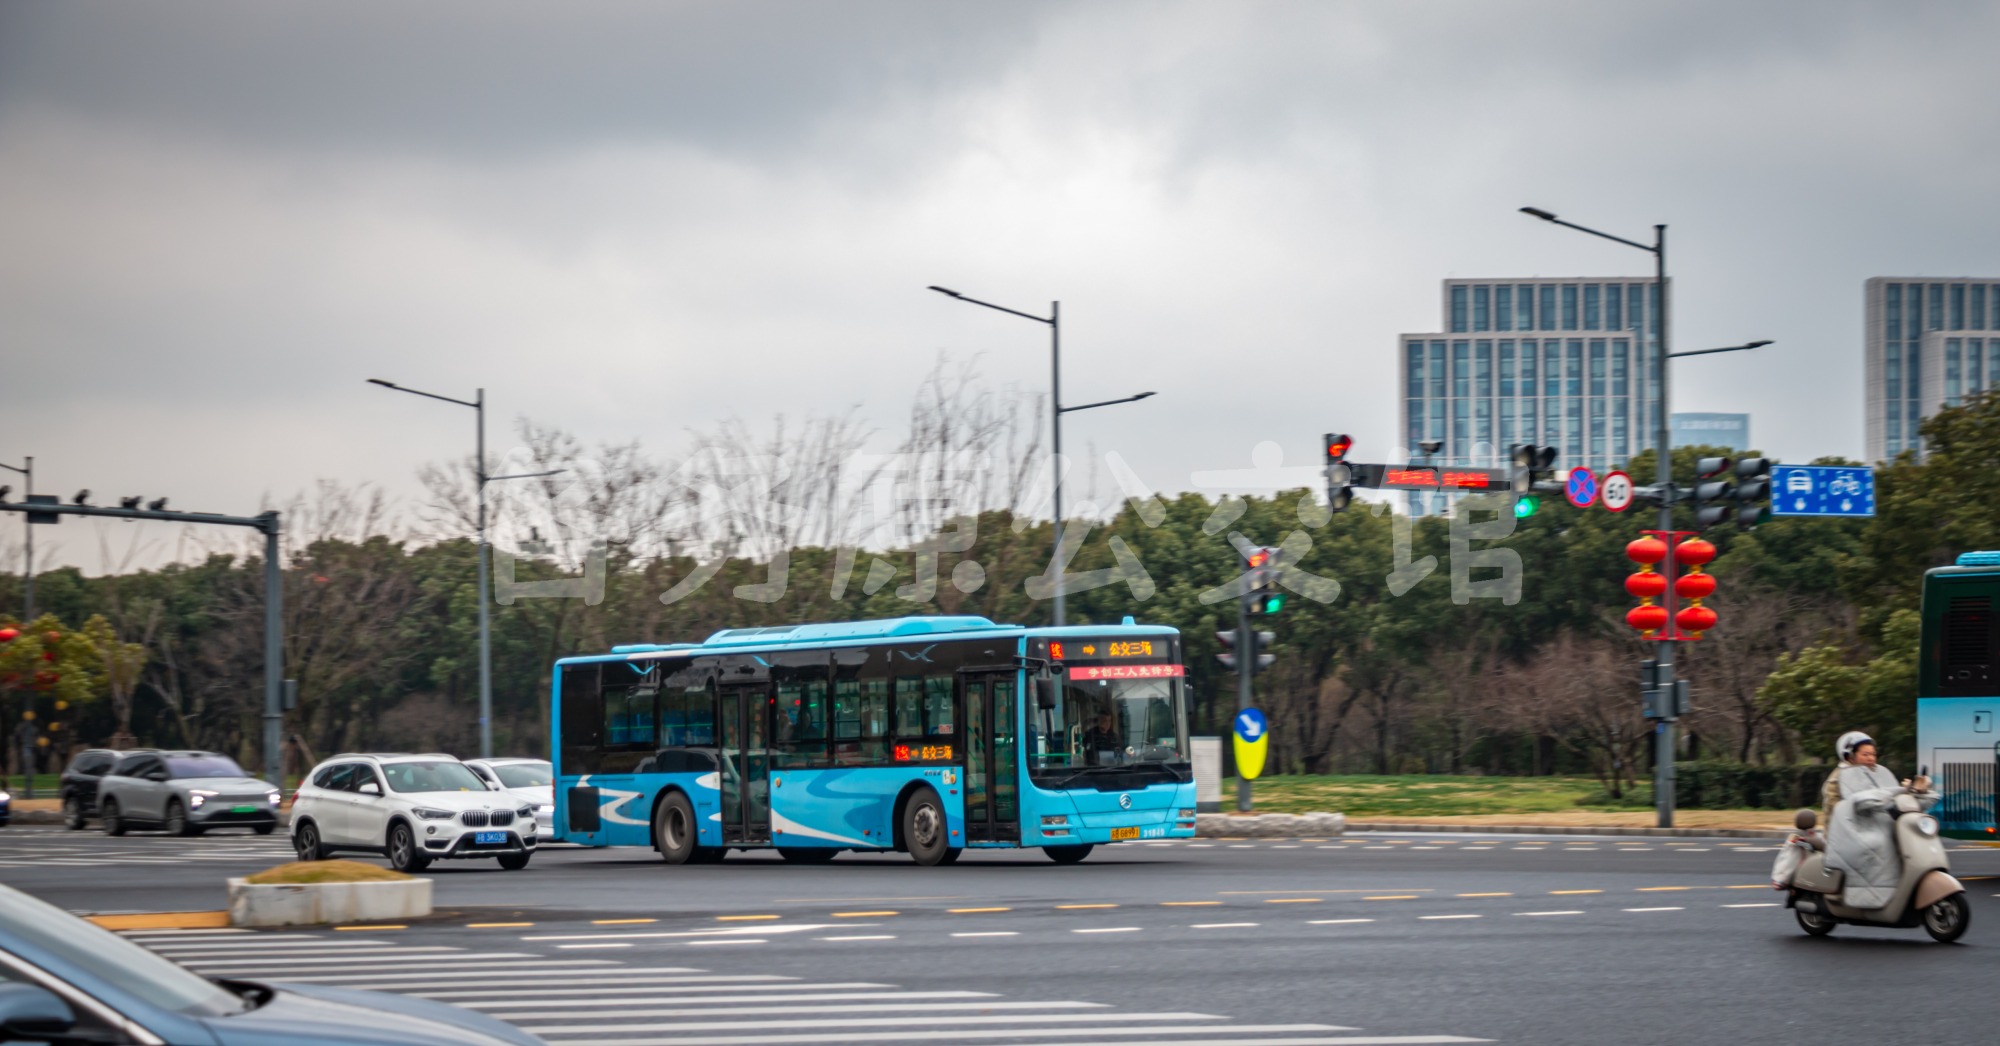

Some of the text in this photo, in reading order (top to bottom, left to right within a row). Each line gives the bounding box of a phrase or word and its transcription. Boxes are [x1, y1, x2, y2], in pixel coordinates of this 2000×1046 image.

[1607, 482, 1626, 501] 60
[1109, 641, 1152, 656] 公交三场
